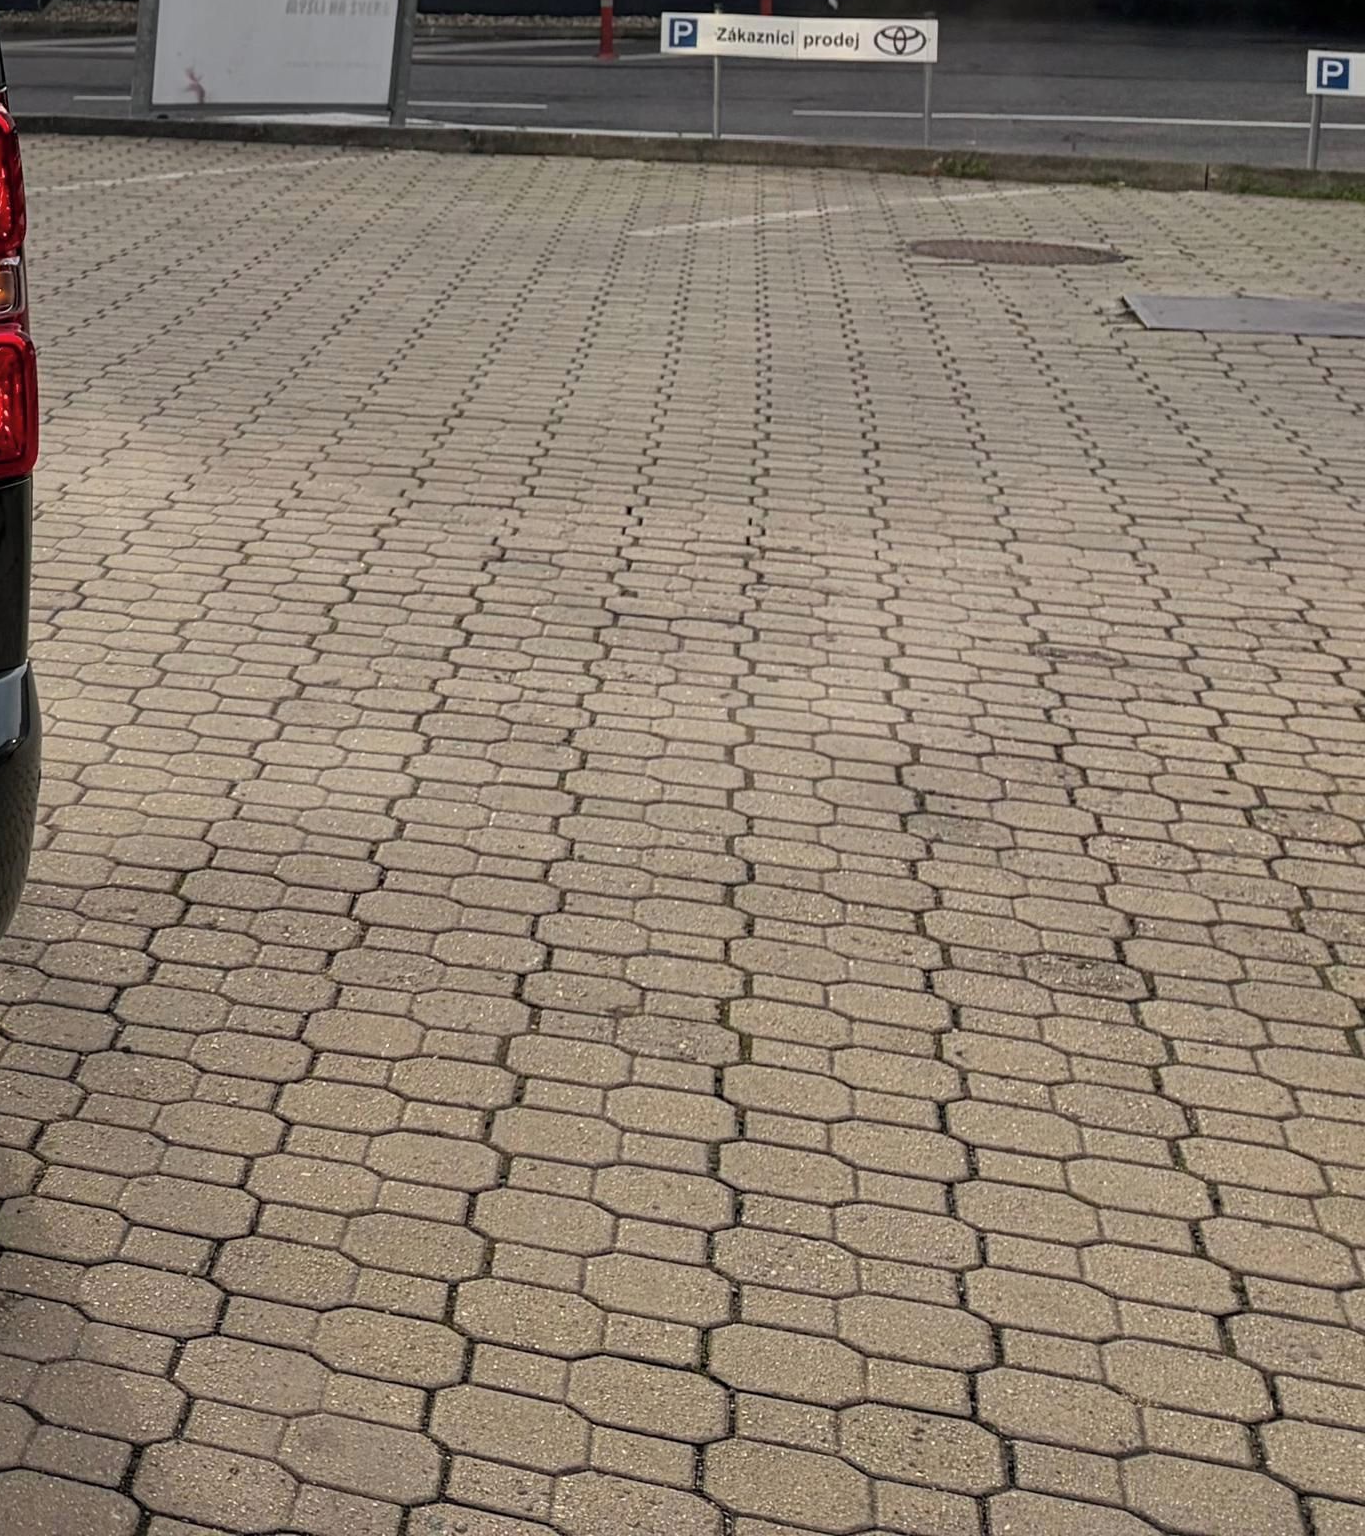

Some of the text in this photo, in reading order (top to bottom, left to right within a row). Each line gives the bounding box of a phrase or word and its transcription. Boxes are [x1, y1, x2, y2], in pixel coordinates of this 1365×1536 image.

[673, 21, 693, 45] P
[803, 31, 860, 50] prodej
[1322, 60, 1344, 85] P
